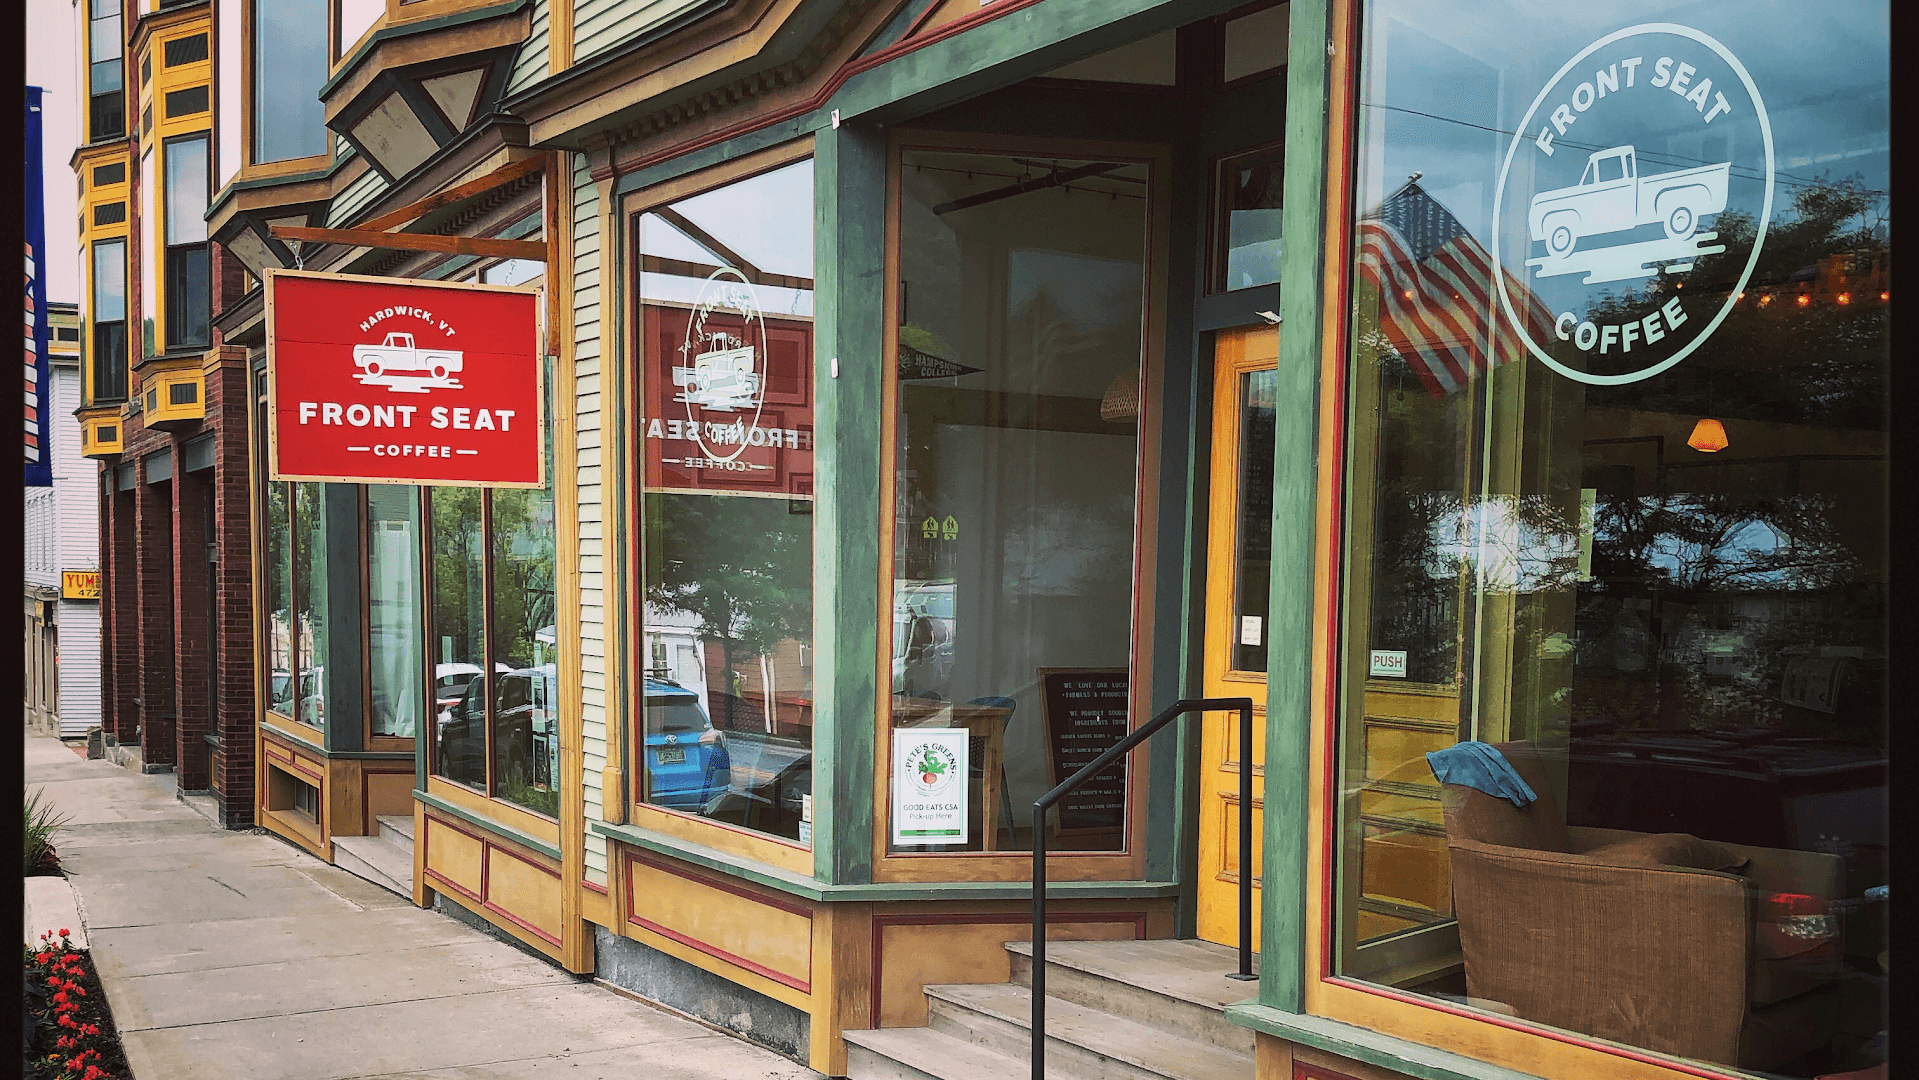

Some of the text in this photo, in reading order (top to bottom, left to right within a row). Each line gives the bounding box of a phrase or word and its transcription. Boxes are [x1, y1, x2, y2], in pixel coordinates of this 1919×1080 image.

[1535, 57, 1732, 157] FRONT SEAT
[360, 306, 456, 337] HARDWICK, VT
[695, 285, 727, 334] FRONT
[1555, 296, 1688, 354] COFFEE
[915, 354, 962, 371] HAMPSHIRE
[921, 367, 957, 377] COLLEGE
[299, 402, 515, 431] FRONT SEAT
[704, 415, 746, 446] COFFEE
[373, 444, 451, 458] COFFEE
[1374, 655, 1402, 667] PUSH
[905, 743, 957, 770] PETE'S GREENS
[926, 803, 943, 811] EATS
[945, 803, 958, 811] CSA
